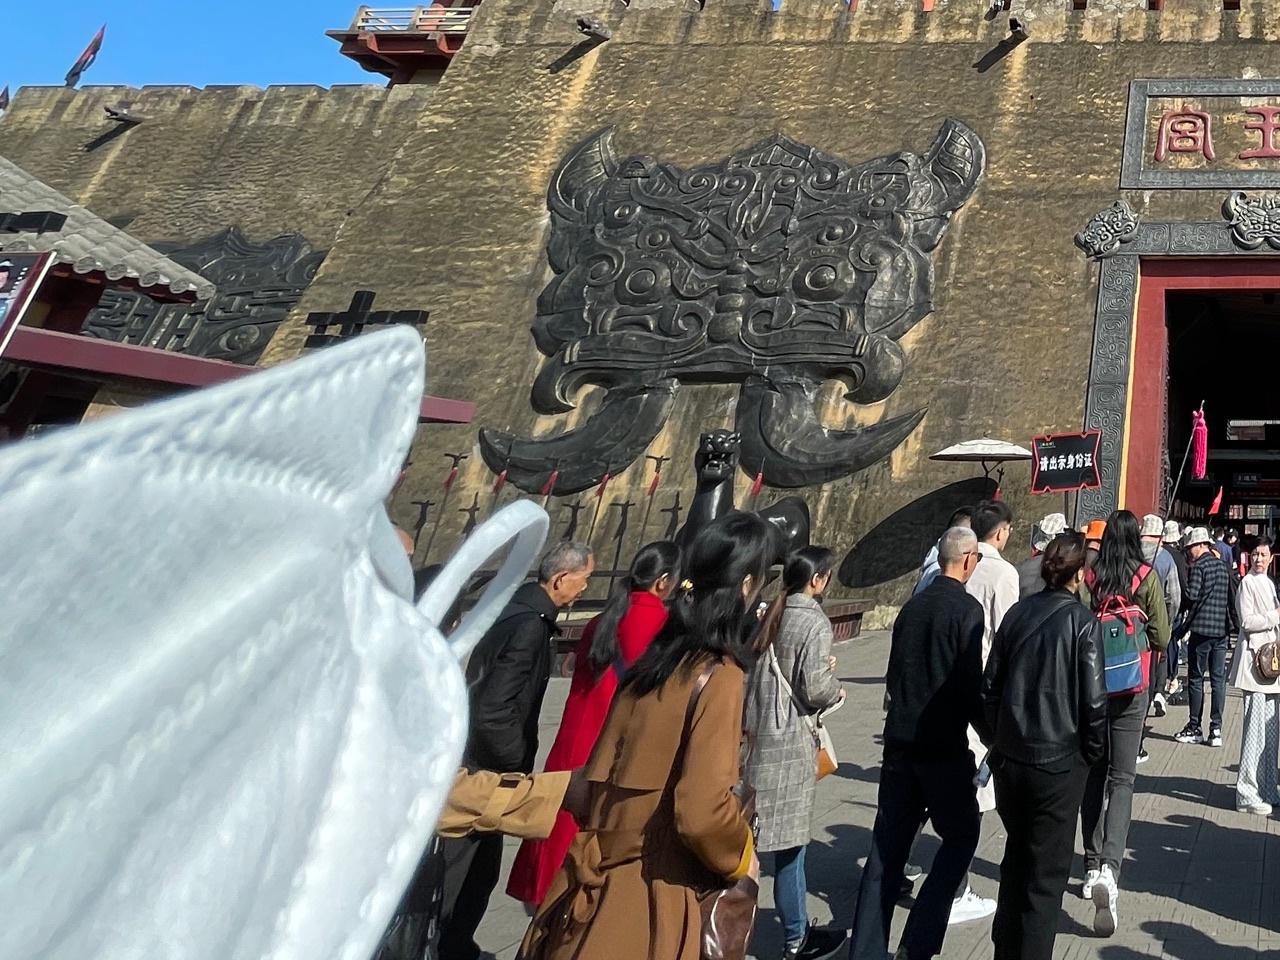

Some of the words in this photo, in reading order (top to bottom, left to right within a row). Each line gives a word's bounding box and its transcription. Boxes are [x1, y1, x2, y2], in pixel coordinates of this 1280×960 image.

[1040, 453, 1093, 471] 请出示身份证
